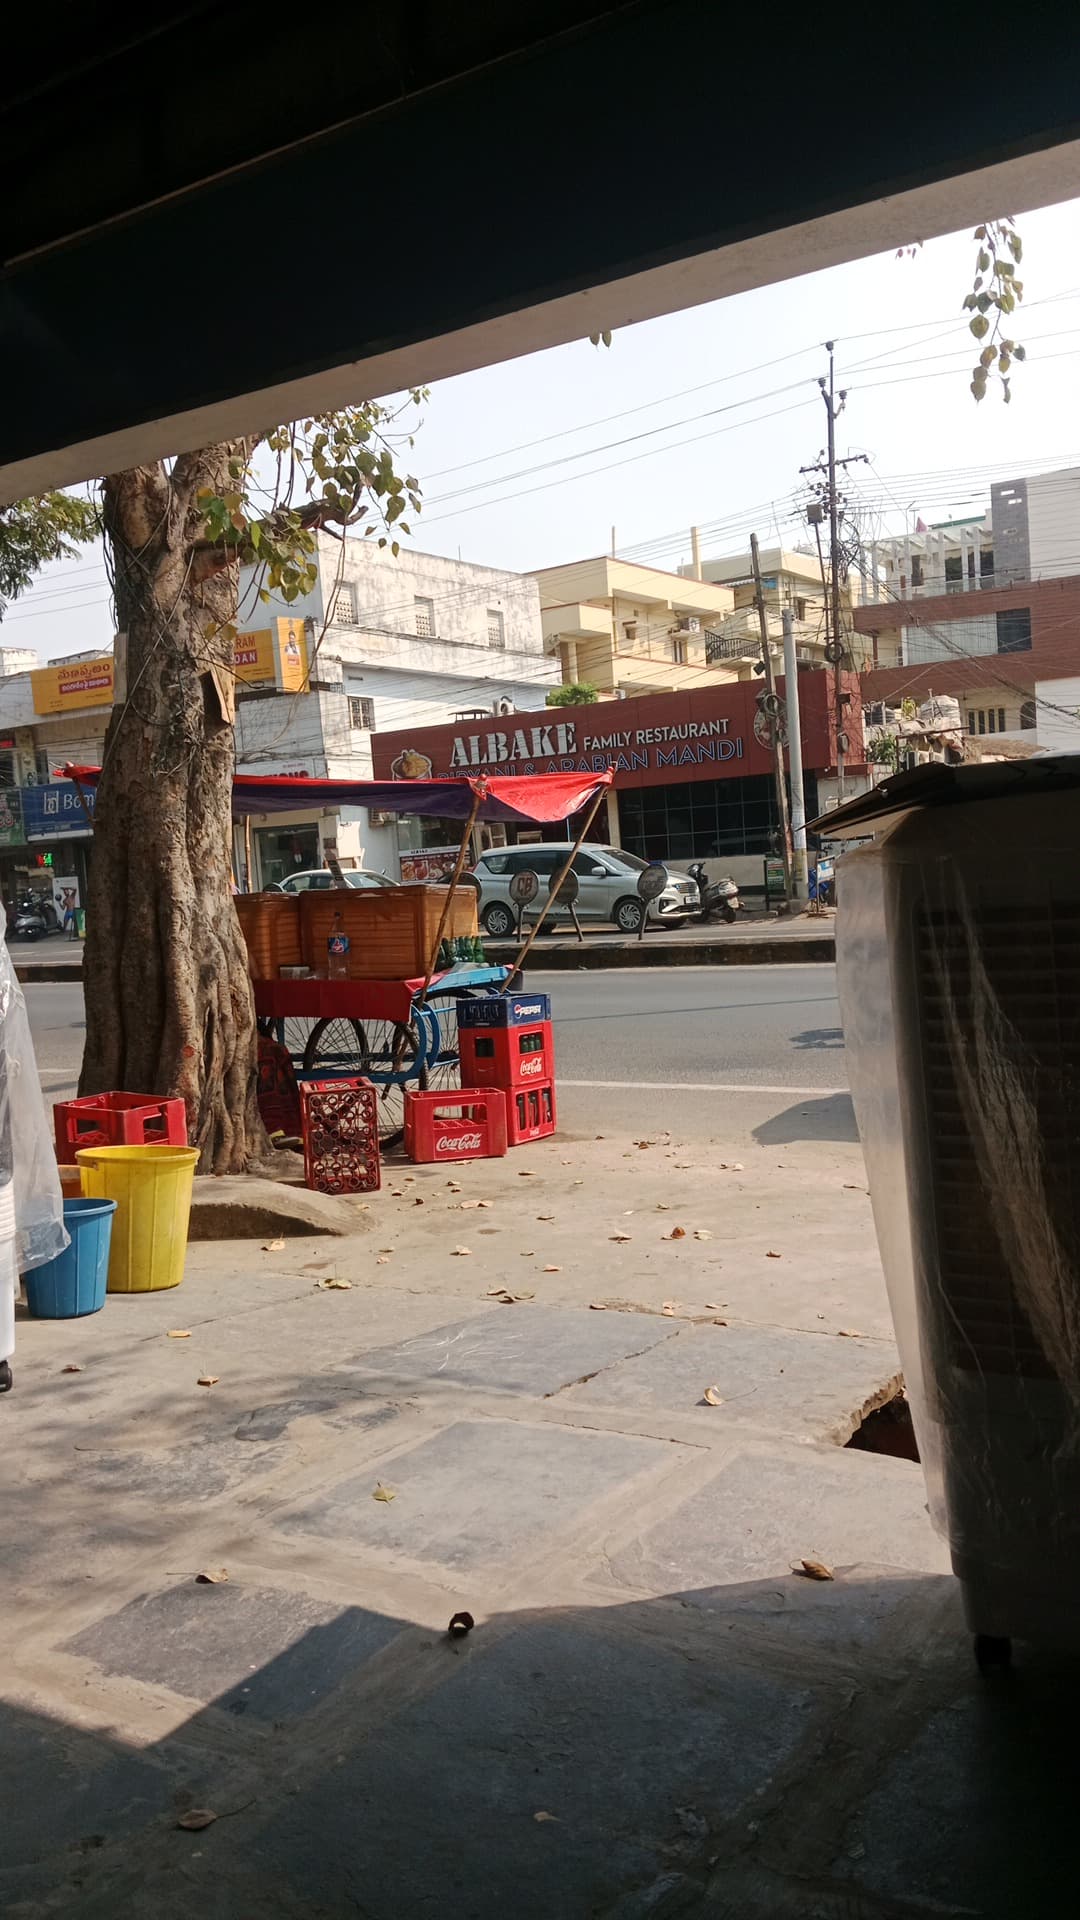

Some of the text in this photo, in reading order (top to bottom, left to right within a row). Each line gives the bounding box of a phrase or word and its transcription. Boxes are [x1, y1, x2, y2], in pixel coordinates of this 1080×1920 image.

[449, 718, 729, 768] ALBAKE FAMILY RESTAURANT
[656, 737, 743, 768] MANDI
